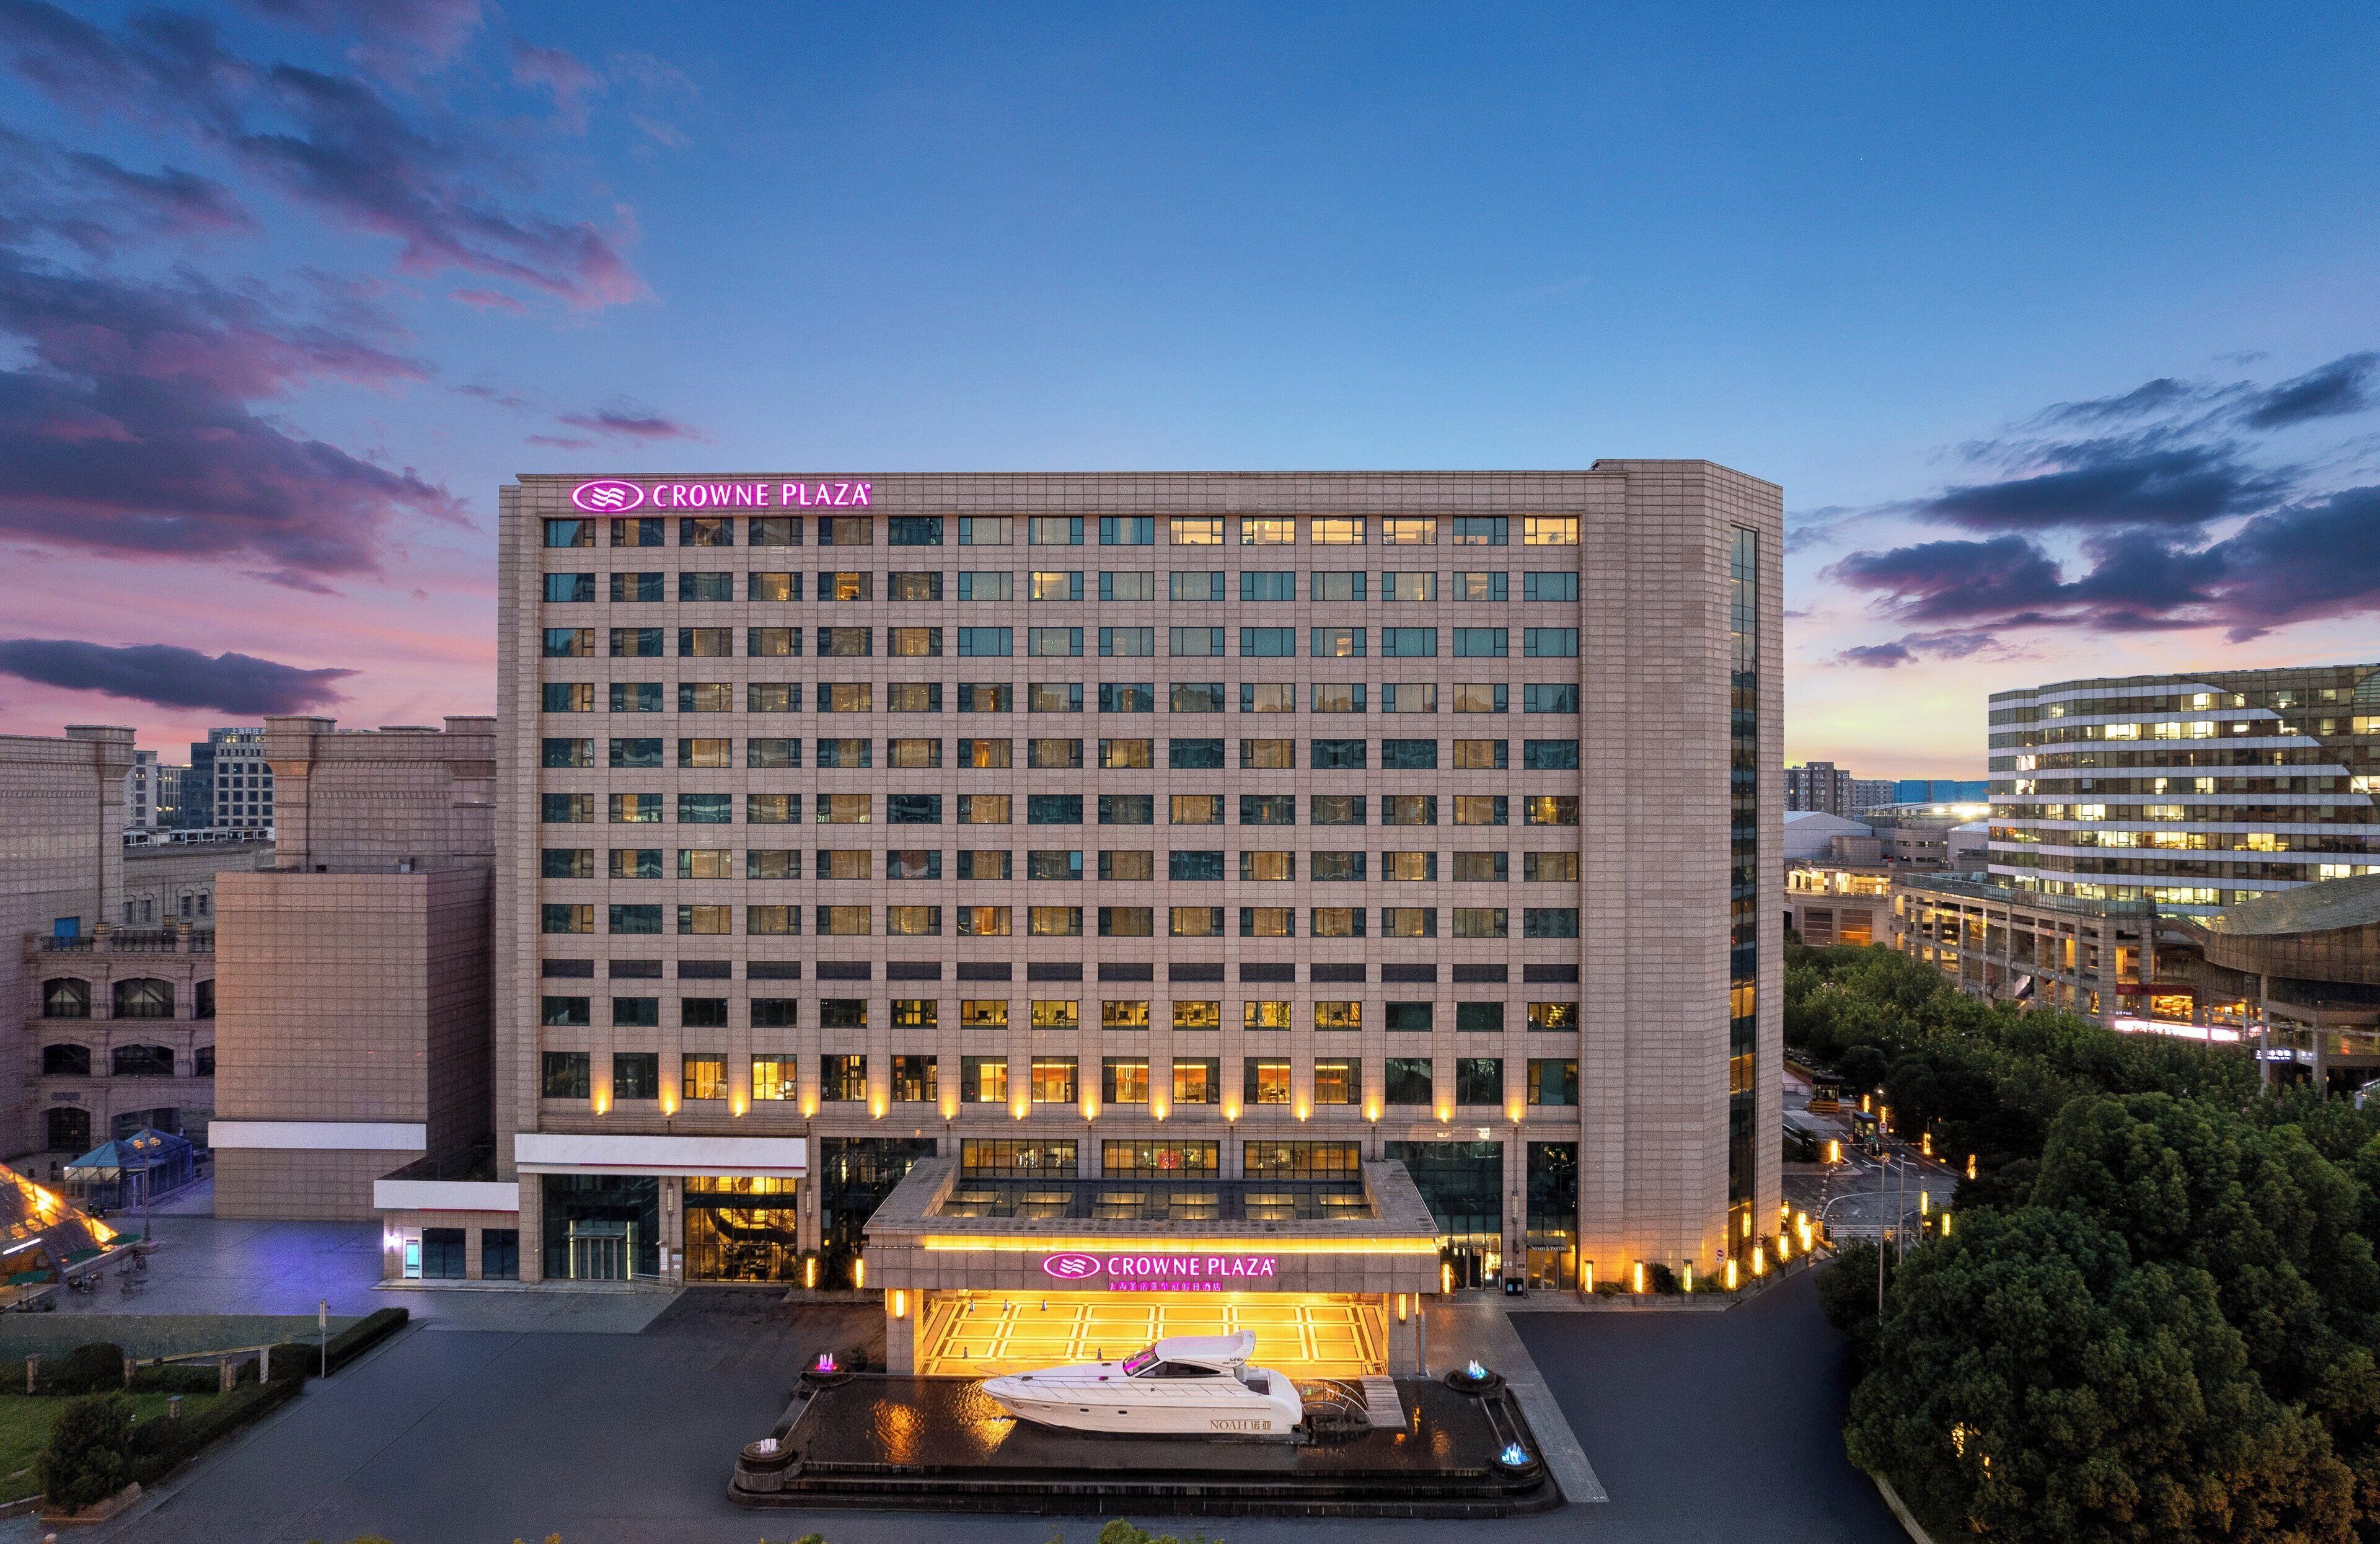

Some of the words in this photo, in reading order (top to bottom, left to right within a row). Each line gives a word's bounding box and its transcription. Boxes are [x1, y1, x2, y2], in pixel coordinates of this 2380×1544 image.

[653, 484, 769, 506] CROWNE
[782, 483, 868, 505] PLAZA
[1108, 1257, 1199, 1275] CROWNE
[1208, 1258, 1273, 1276] PLAZA
[1210, 1420, 1246, 1429] NOAH
[1251, 1421, 1271, 1430] 诺亚
